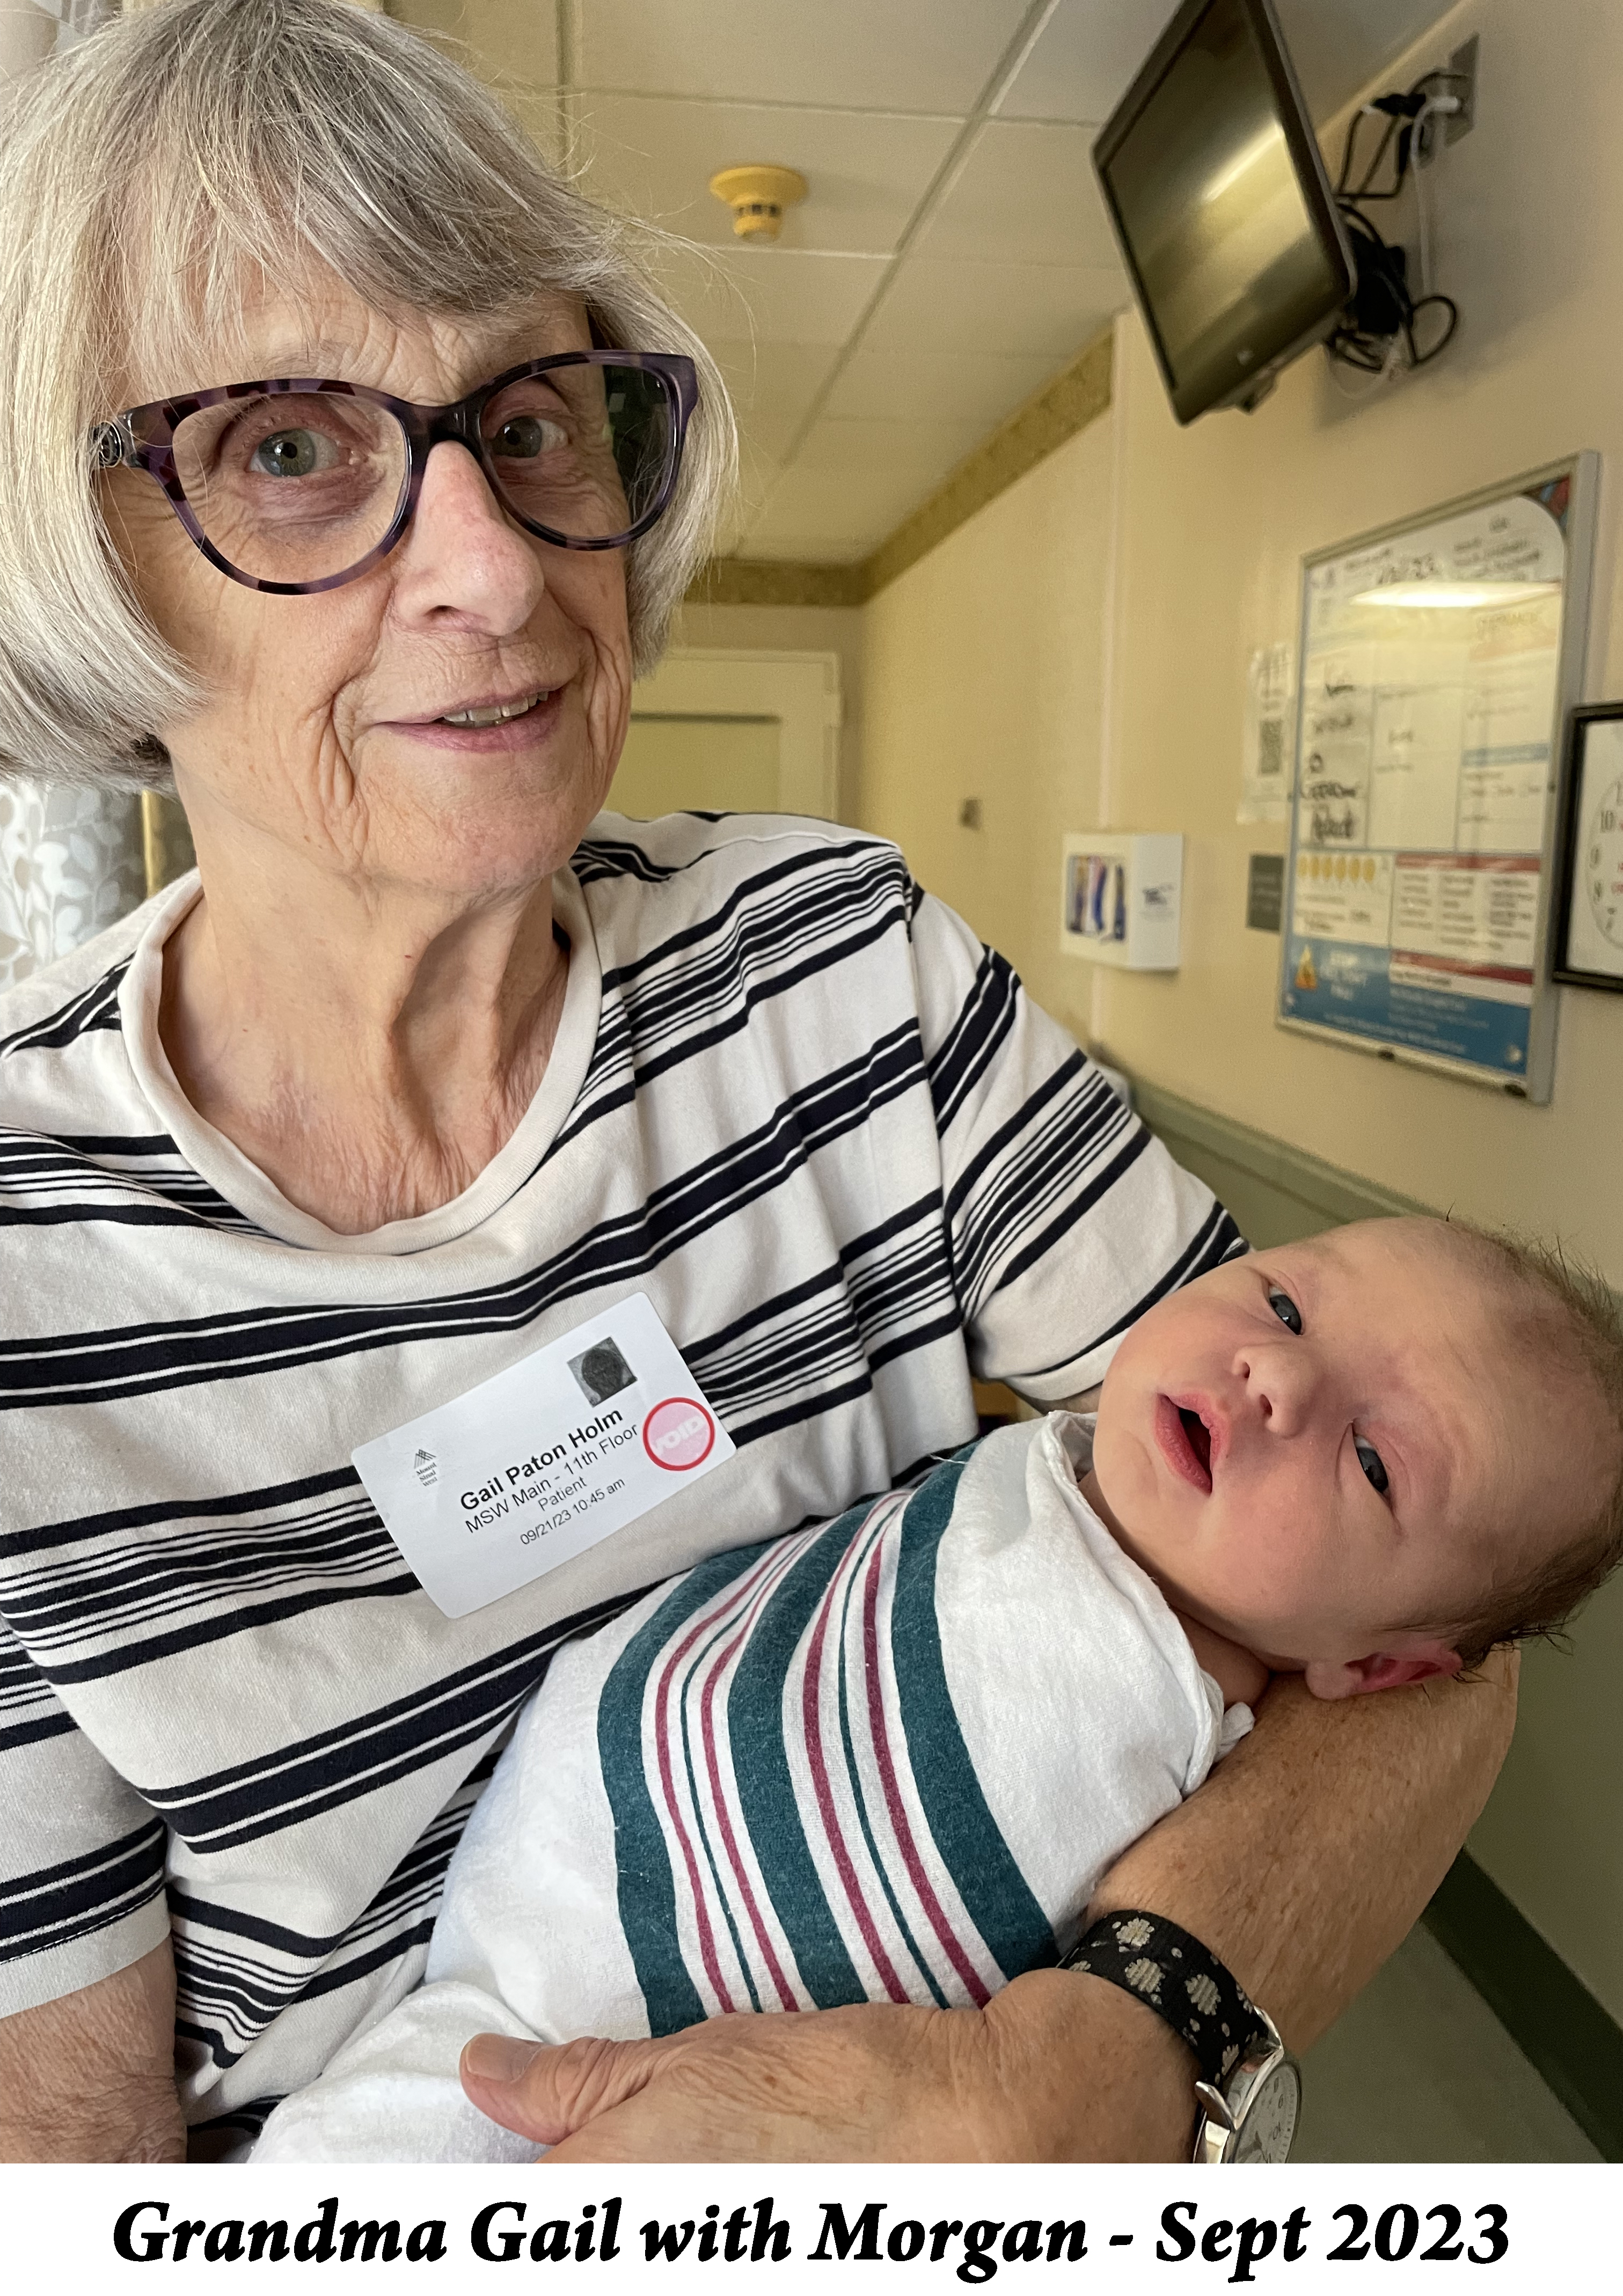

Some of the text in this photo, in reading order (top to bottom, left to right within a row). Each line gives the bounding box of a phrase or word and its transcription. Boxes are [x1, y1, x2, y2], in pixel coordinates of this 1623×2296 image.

[1600, 810, 1615, 833] 10
[652, 1415, 706, 1456] VOID
[416, 1462, 437, 1476] Mount
[460, 1410, 623, 1510] Gail Paton Holm
[465, 1499, 509, 1533] MSW
[511, 1478, 551, 1507] Main
[564, 1451, 598, 1475] 11th
[598, 1424, 638, 1454] Floor
[520, 1478, 625, 1544] 09/21/23 10:45 am
[538, 1477, 587, 1512] Patient
